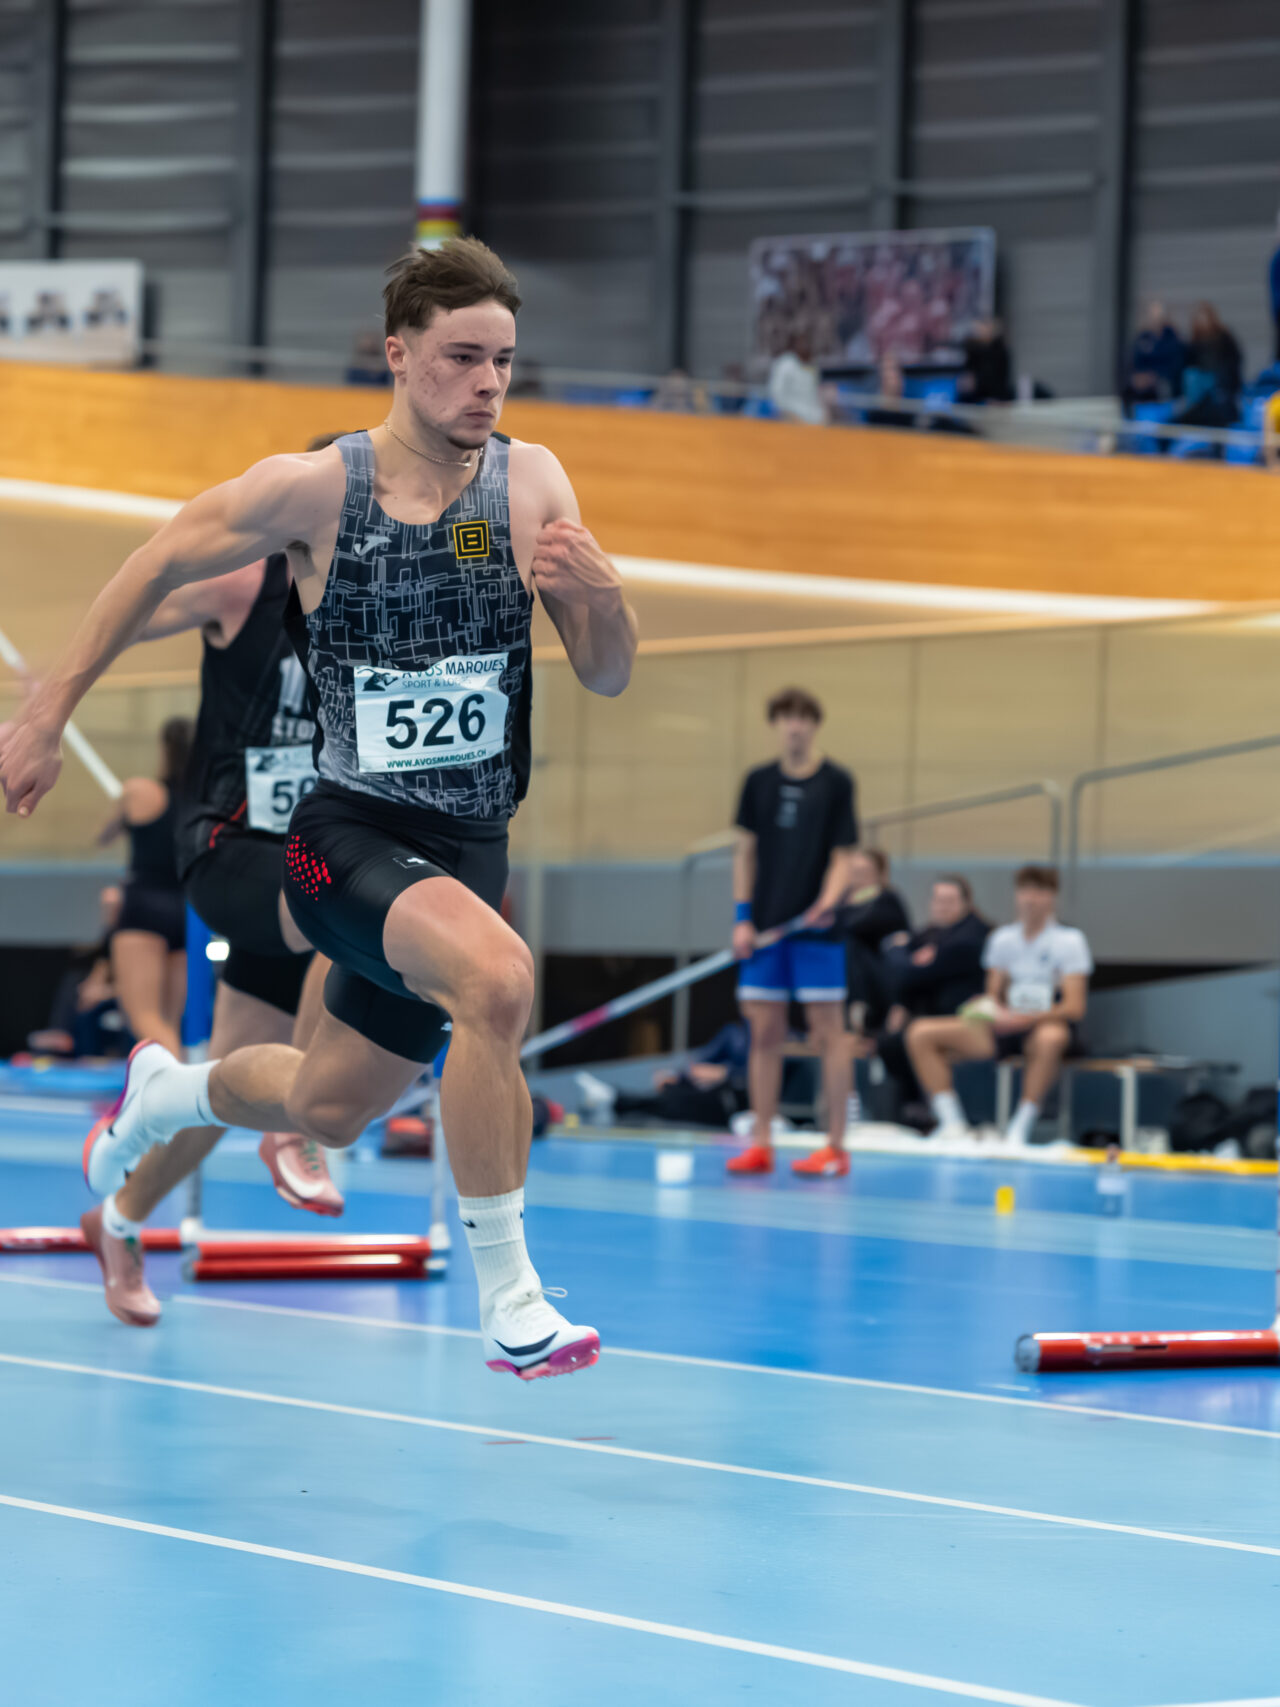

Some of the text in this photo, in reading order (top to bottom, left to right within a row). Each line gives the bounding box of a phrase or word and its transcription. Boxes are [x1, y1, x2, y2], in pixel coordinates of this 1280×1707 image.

[445, 658, 505, 675] MARQUES
[402, 679, 432, 689] SPORT
[434, 679, 441, 687] &
[386, 693, 487, 750] 526
[387, 748, 487, 769] WWW.AVOSMARQUES.CH
